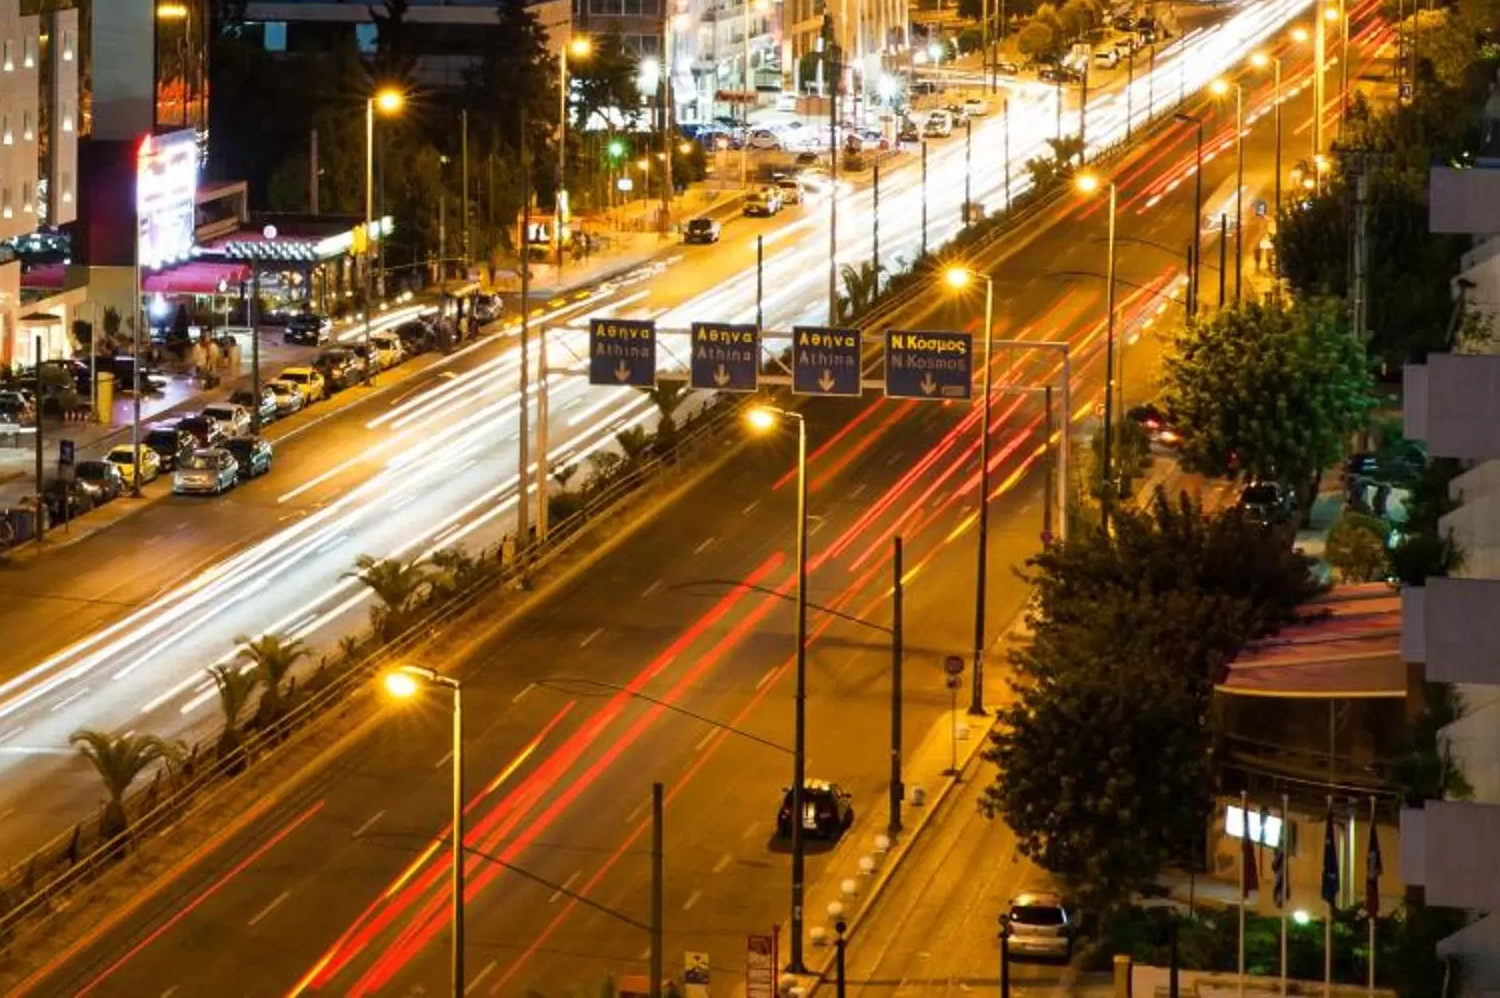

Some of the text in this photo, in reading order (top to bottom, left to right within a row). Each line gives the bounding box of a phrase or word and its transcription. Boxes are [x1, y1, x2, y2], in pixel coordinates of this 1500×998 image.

[595, 341, 650, 358] Athina
[697, 345, 751, 362] Athina
[799, 350, 854, 366] Athina
